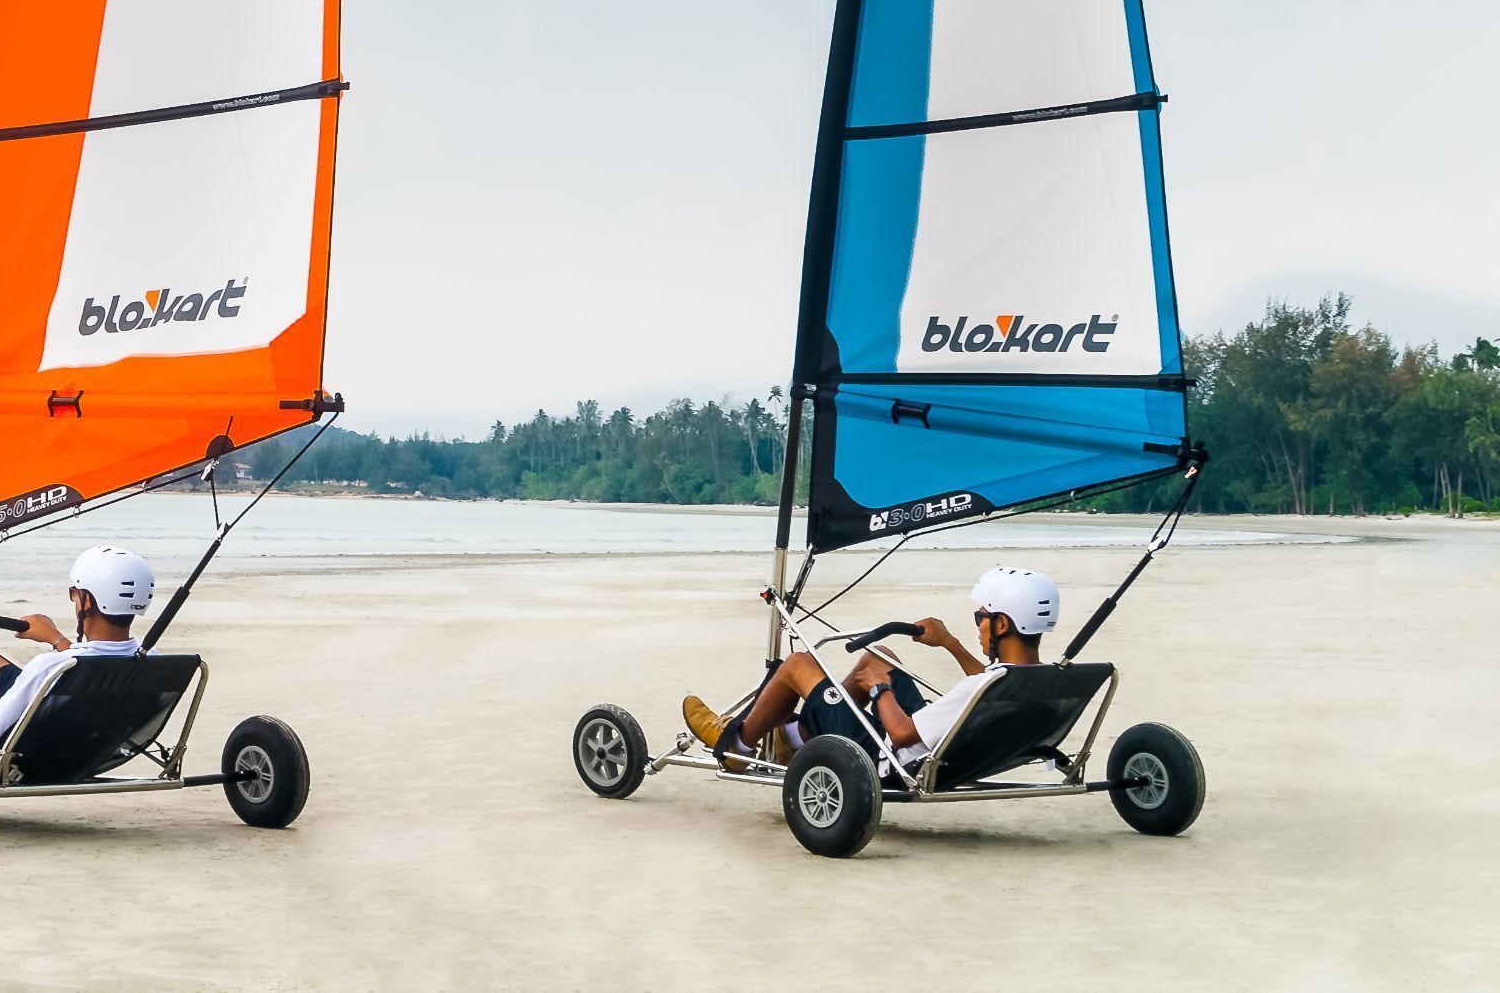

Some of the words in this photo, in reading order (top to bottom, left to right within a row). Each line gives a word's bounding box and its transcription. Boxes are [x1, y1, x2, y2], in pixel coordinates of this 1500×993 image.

[26, 486, 67, 508] HD
[50, 495, 68, 506] DUTY
[925, 493, 972, 514] HD
[953, 503, 973, 512] DUTY
